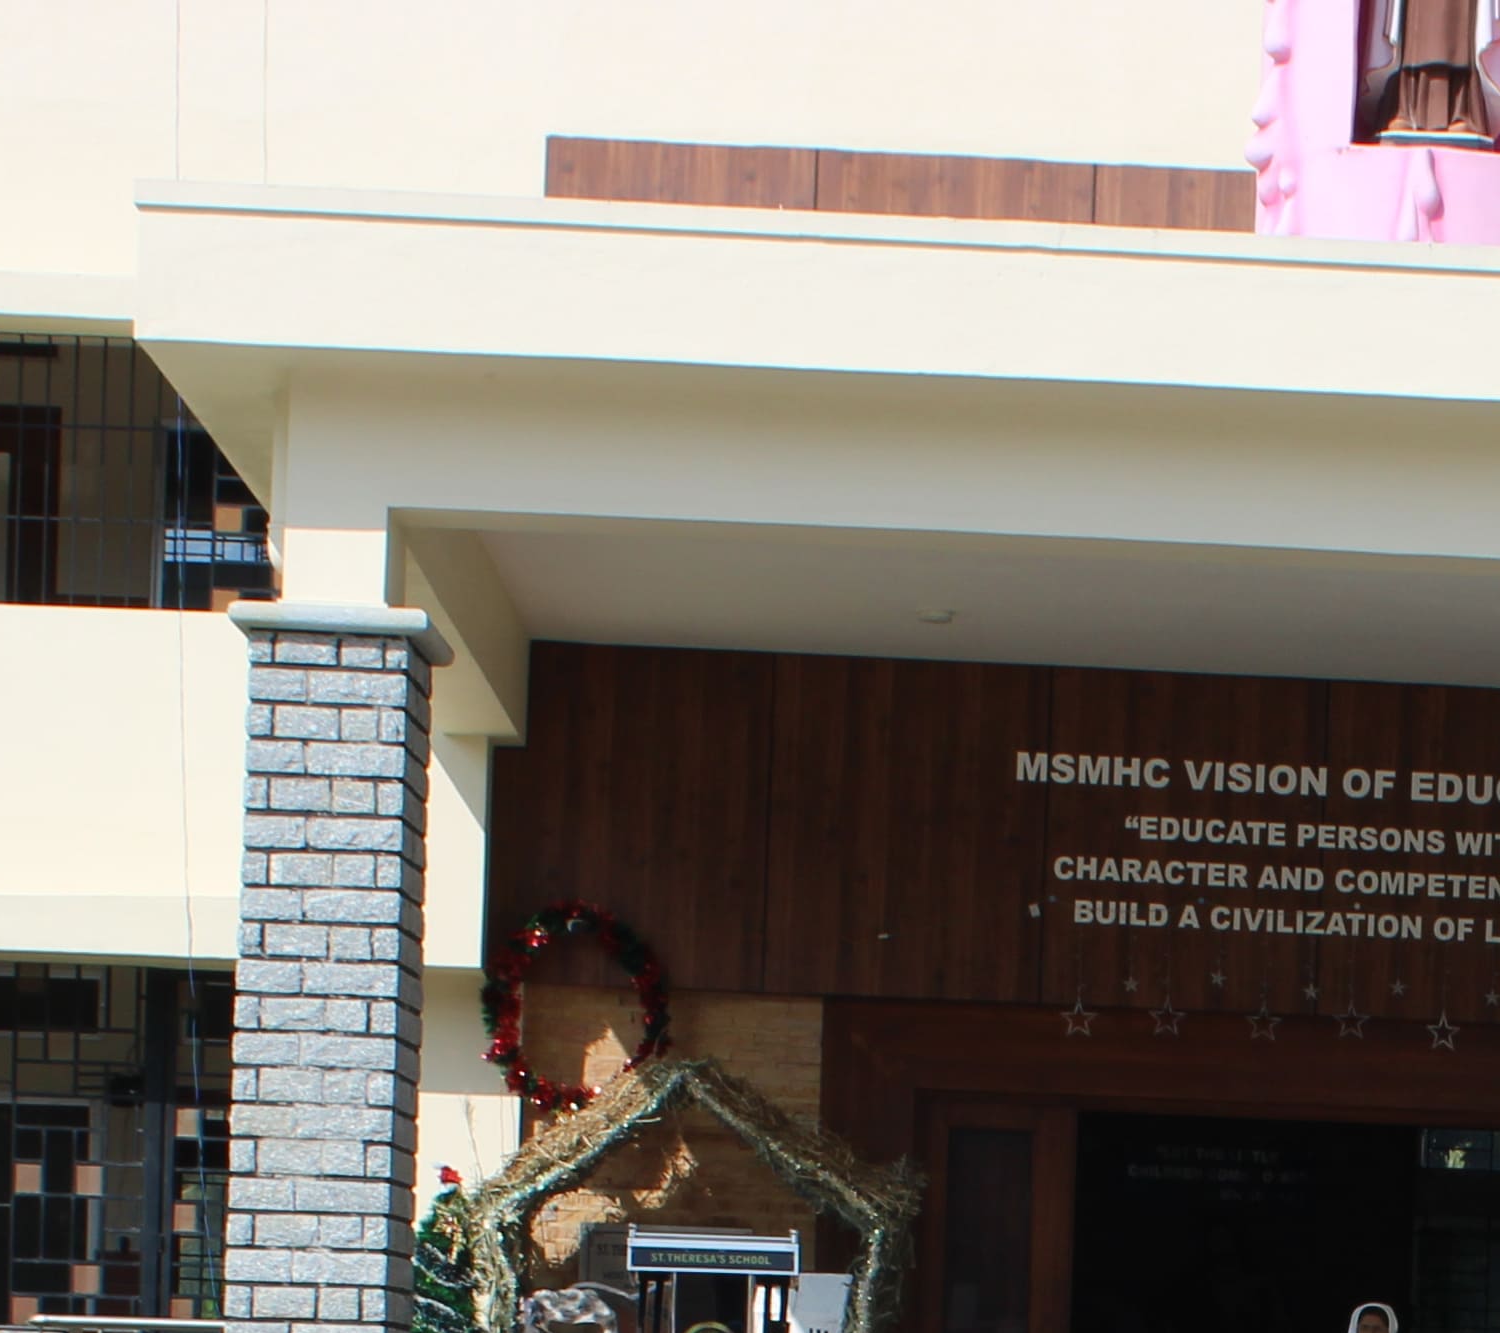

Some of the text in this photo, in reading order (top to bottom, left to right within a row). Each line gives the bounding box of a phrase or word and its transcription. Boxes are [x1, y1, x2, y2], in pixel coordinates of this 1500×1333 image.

[1016, 751, 1170, 788] MSMHC
[1184, 759, 1328, 796] VISION
[1342, 768, 1396, 799] OF
[1124, 815, 1286, 847] “EDUCATE
[1297, 823, 1446, 854] PERSONS
[1053, 856, 1248, 888] CHARACTER
[1257, 865, 1324, 891] AND
[1074, 899, 1169, 927] BUILD
[1178, 904, 1200, 929] A
[1210, 906, 1422, 939] CIVILIZATION
[1433, 916, 1475, 941] OF
[668, 1253, 726, 1265] THERESA'S
